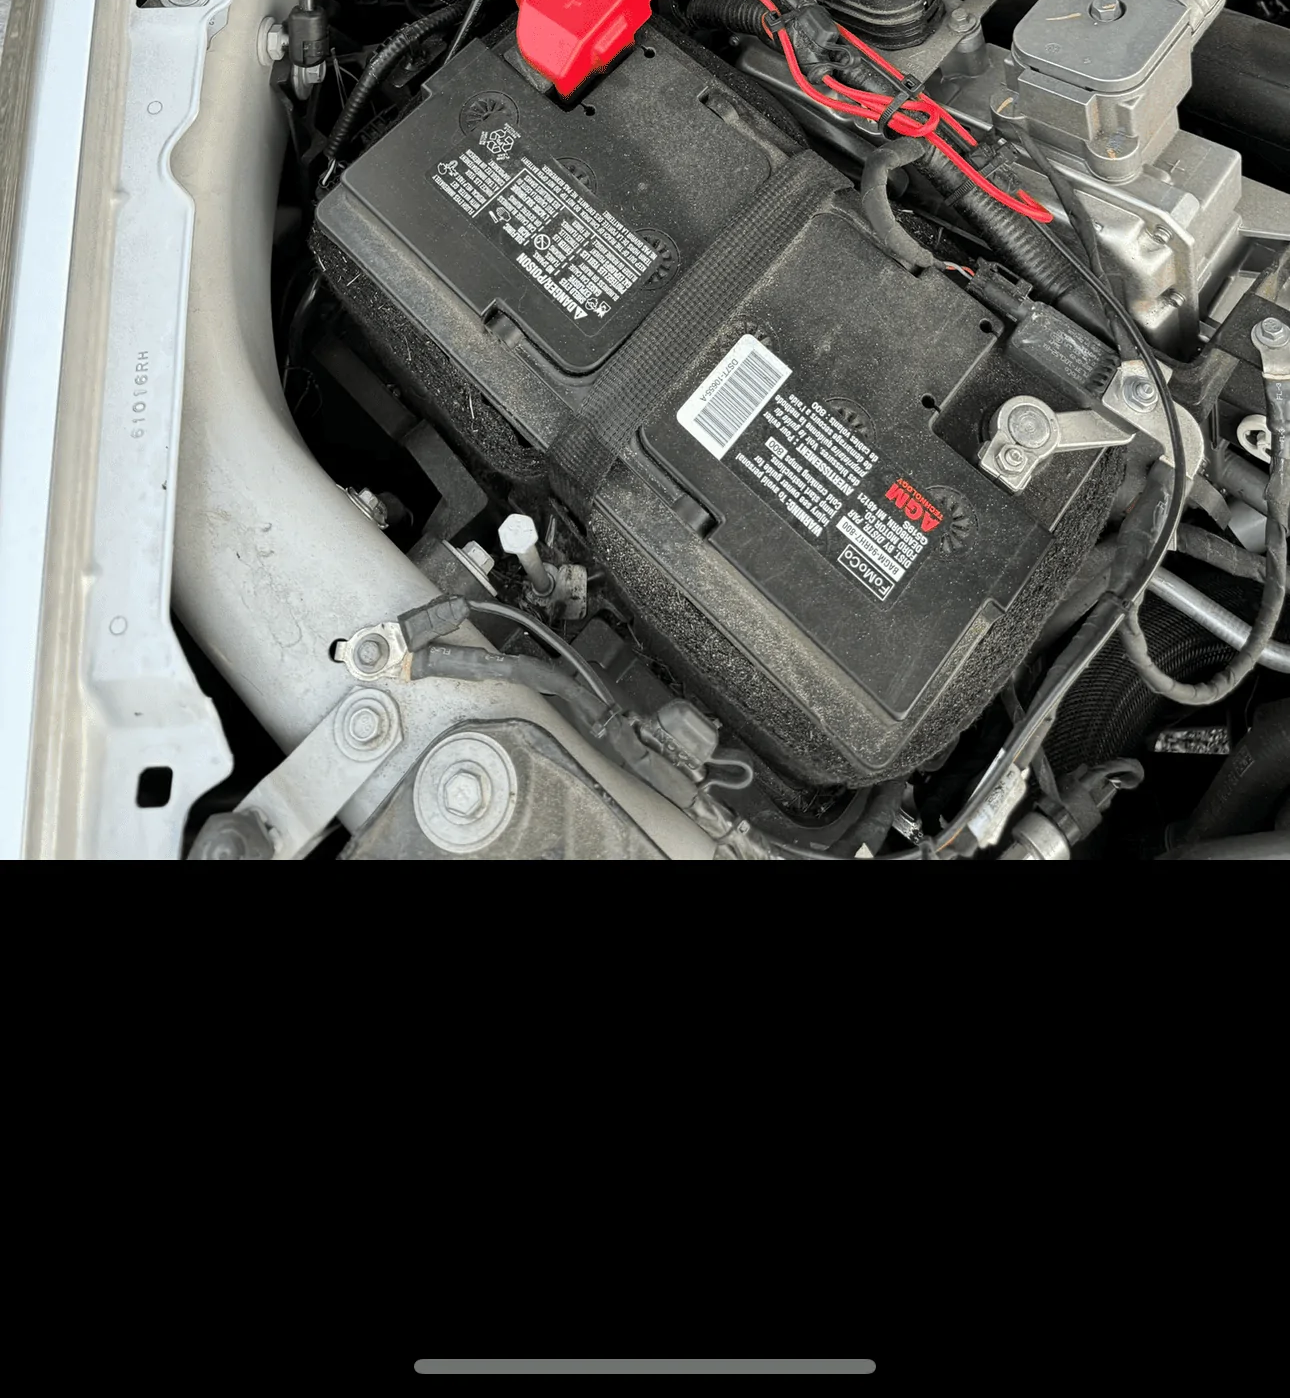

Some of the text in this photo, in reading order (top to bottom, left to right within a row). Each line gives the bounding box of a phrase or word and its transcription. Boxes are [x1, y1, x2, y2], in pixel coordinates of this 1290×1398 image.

[520, 155, 539, 173] BATTERY!
[536, 169, 549, 182] OPEN
[540, 163, 566, 187] RENVERSER.
[449, 179, 460, 189] GET
[545, 178, 556, 189] NOT
[552, 184, 561, 193] DO
[561, 183, 573, 194] PAS
[452, 193, 464, 205] EYES
[557, 189, 568, 200] TIP.
[565, 196, 576, 207] NOT
[569, 190, 579, 199] NE
[460, 201, 475, 215] FLUSH
[468, 197, 481, 210] WITH
[572, 203, 582, 212] DO
[575, 195, 597, 216] ENFANTS.
[514, 211, 529, 226] CAUSE
[577, 208, 600, 230] CHILDREN.
[592, 212, 604, 223] DES
[502, 221, 525, 244] SULFURIC
[516, 224, 531, 239] ACID
[525, 222, 536, 233] CAN
[596, 225, 605, 234] OF
[601, 209, 658, 260] NE PAS OUVRIR LA BATTERIE!
[601, 230, 617, 245] REACH
[614, 232, 624, 241] LA
[620, 237, 630, 246] DE
[613, 241, 624, 252] THE
[620, 247, 630, 257] OF
[626, 242, 641, 256] HORS
[579, 249, 591, 260] LES
[626, 253, 638, 264] OUT
[637, 252, 652, 266] TENIR
[544, 263, 555, 274] NO
[596, 265, 608, 276] LES
[633, 259, 647, 272] KEEP
[515, 252, 578, 311] DANGER/POISON
[566, 273, 592, 298] EXPLOSIVE
[567, 262, 602, 297] GASES CAN CAUSE
[590, 273, 600, 283] OR
[620, 277, 633, 288] GAZ
[558, 276, 586, 304] SHIELD EYES
[596, 278, 620, 301] BLINDNESS
[697, 357, 740, 402] DS7T-10655-A
[127, 349, 153, 439] 61016RH
[787, 392, 807, 412] l'aide
[796, 415, 807, 425] la
[808, 411, 834, 436] secours
[777, 424, 795, 442] Pour
[804, 420, 834, 449] quidonne
[810, 400, 879, 463] de cables volants 800
[772, 406, 861, 487] des blessures. Voir le guide du
[795, 441, 854, 497] AVERTISSEMENT
[861, 459, 873, 471] de
[767, 438, 843, 511] Cold cranking amps 800
[734, 450, 824, 537] WARNING: To avoid personal
[752, 453, 831, 527] injury see owner guide for
[766, 453, 837, 519] jump start instructions.
[896, 475, 944, 521] TECHNOLOGY
[883, 481, 939, 535] AGM
[856, 491, 924, 553] DEARBORN, MI 48121
[846, 508, 912, 569] DIST. BY DISTR. PAR
[861, 508, 918, 561] FORD MOTOR CO.
[900, 519, 929, 546] G519S
[841, 520, 899, 575] BAGM-94RH7-800
[841, 547, 891, 595] FoMoCo
